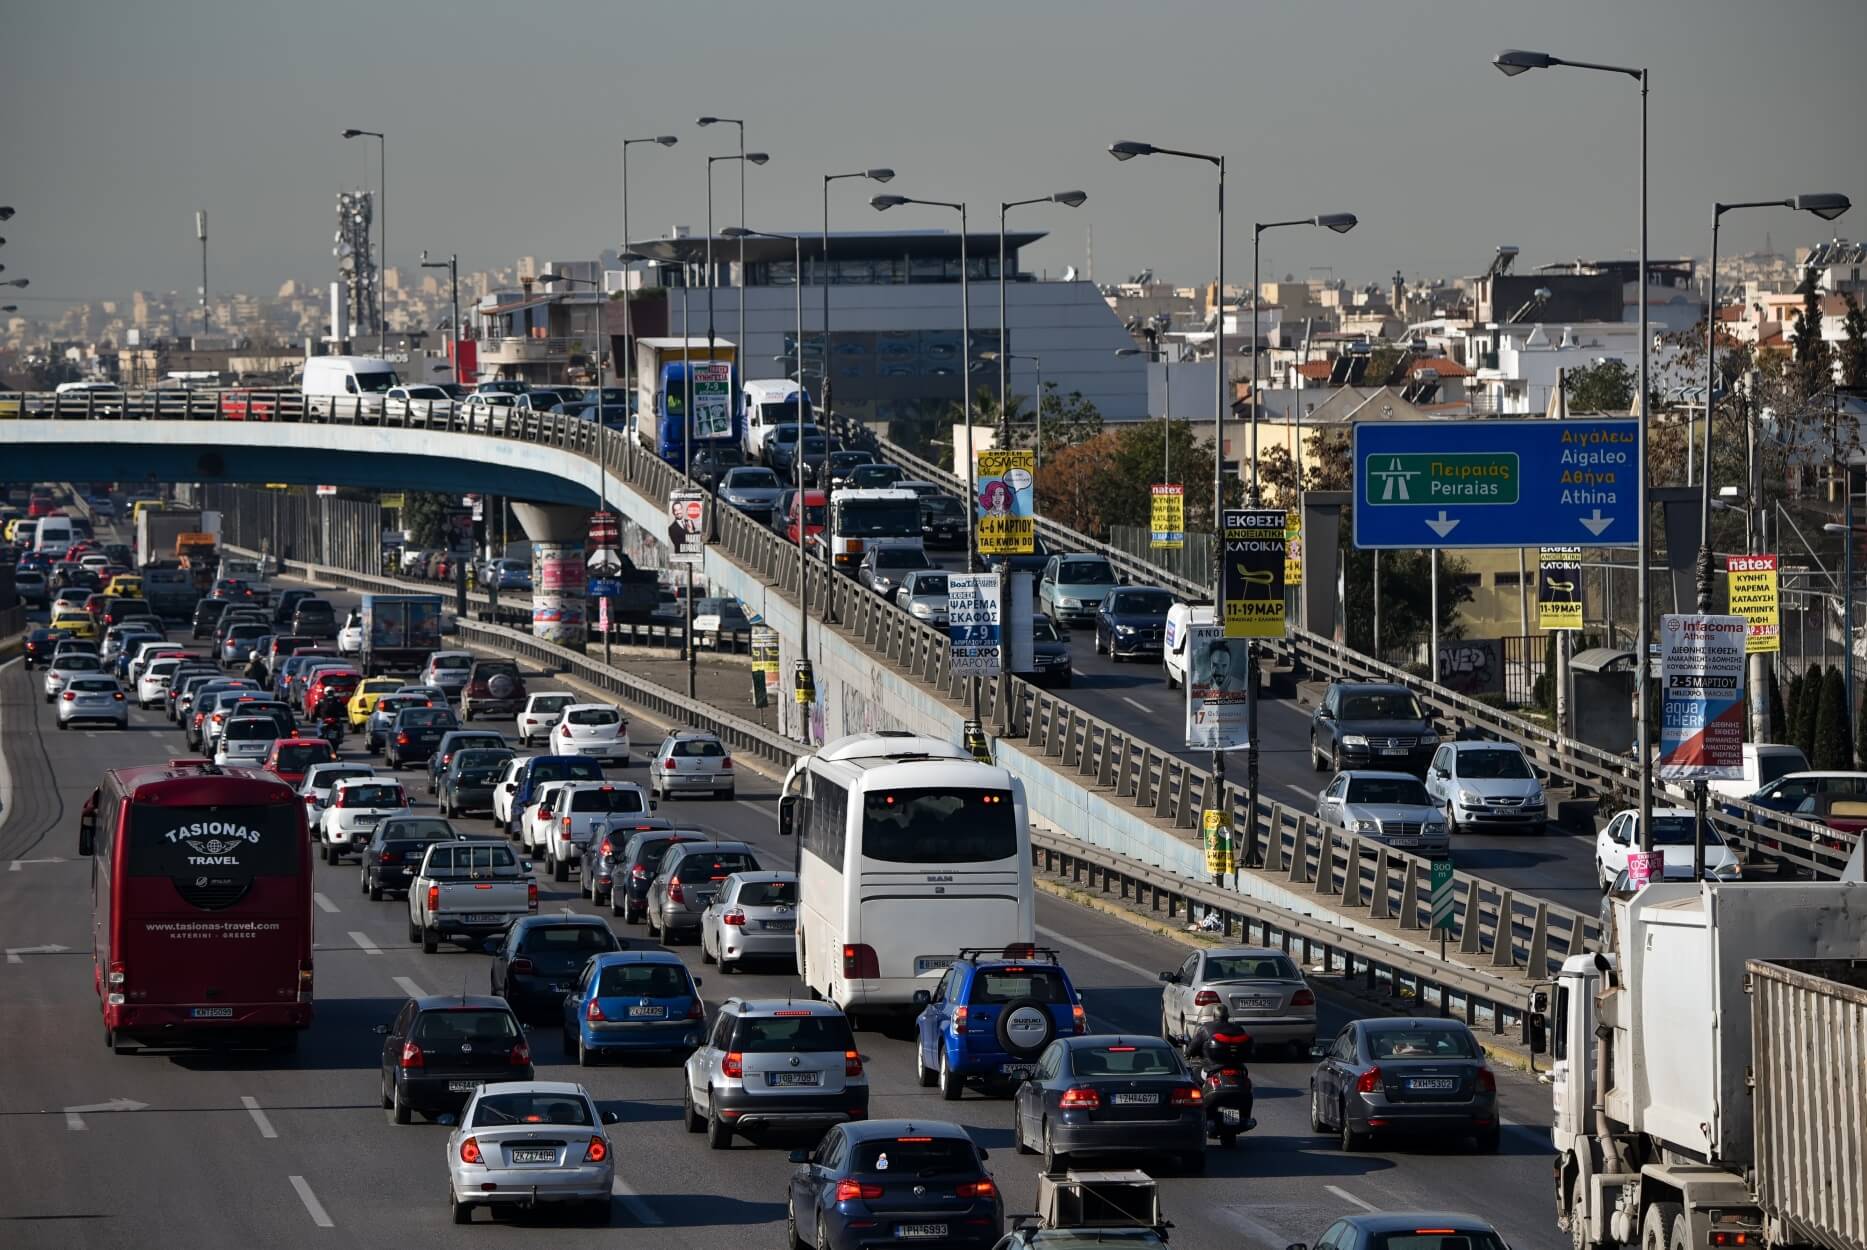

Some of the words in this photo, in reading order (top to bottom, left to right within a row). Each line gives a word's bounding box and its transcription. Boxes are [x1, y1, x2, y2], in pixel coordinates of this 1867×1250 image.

[1561, 428, 1634, 446] Αιγάλεω
[979, 456, 1033, 467] COSMETIC
[1561, 449, 1627, 467] Aigaleo
[1431, 460, 1510, 479] Πειραιάς
[1561, 468, 1616, 486] Αθήνα
[1152, 486, 1183, 494] natex
[1431, 480, 1499, 496] Peiraias
[1561, 489, 1617, 505] Athina
[980, 519, 995, 533] 4-6
[997, 519, 1032, 533] ΜΑΡΤΙΟΥ
[1227, 515, 1285, 527] ΕΚΘΕΣΗ
[1729, 559, 1773, 571] natex
[1736, 574, 1767, 582] ΚΥΝΗΓΙ
[1734, 584, 1770, 593] ΨΑΡΕΜΑ
[1732, 594, 1774, 603] ΚΑΤΑΔΥΣΗ
[950, 600, 997, 609] ΨΑΡΕΜΑ
[1732, 605, 1775, 614] ΚΑΜΠΙΝΓΚ
[950, 611, 998, 622] ΣΚΑΦΟΣ
[1683, 620, 1744, 633] Infacoma
[1684, 632, 1715, 641] Athens
[951, 648, 1000, 658] HELEXPO
[1671, 646, 1706, 654] ΔΙΕΘΝΗΣ
[1708, 647, 1738, 655] ΕΚΘΕΣΗ
[1693, 677, 1736, 688] ΜΑΡΤΙΟΥ
[1665, 702, 1698, 715] aqua
[1194, 711, 1206, 725] 17
[165, 822, 261, 844] TASIONAS
[187, 856, 240, 865] TRAVEL
[1433, 863, 1451, 872] 300
[1438, 871, 1447, 879] m
[146, 921, 280, 932] www.tasionas-travel.com
